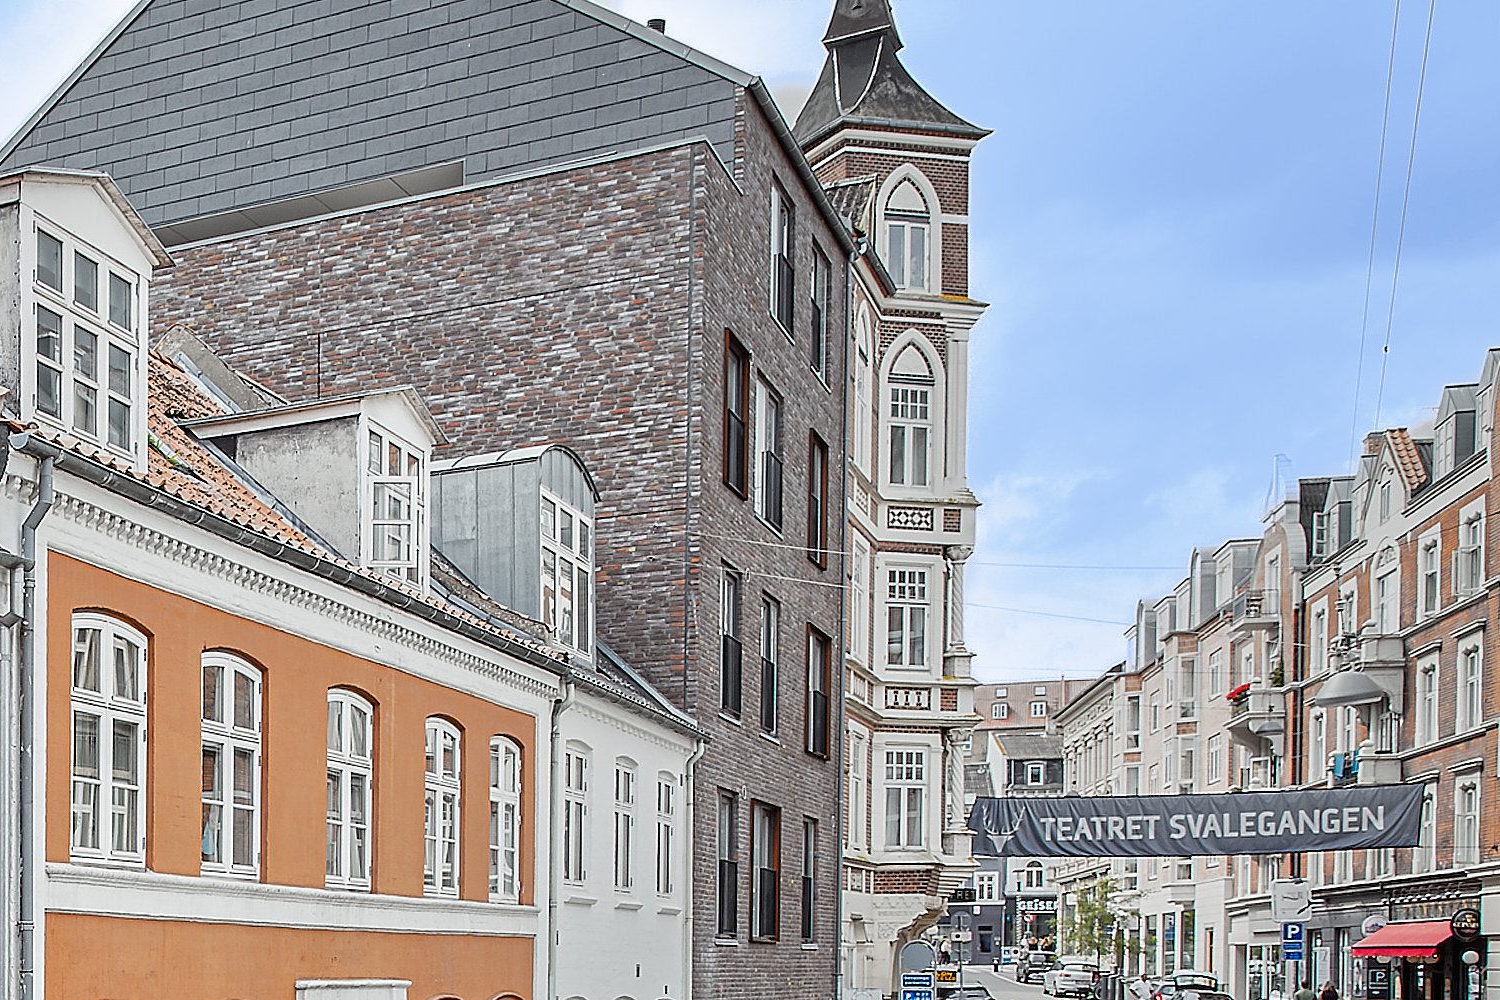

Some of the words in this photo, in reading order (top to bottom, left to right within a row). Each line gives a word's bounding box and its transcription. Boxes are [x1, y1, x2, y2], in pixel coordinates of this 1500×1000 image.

[1039, 815, 1160, 842] TEATRET
[1169, 805, 1385, 840] SVALEGANGEN
[1287, 924, 1300, 939] P
